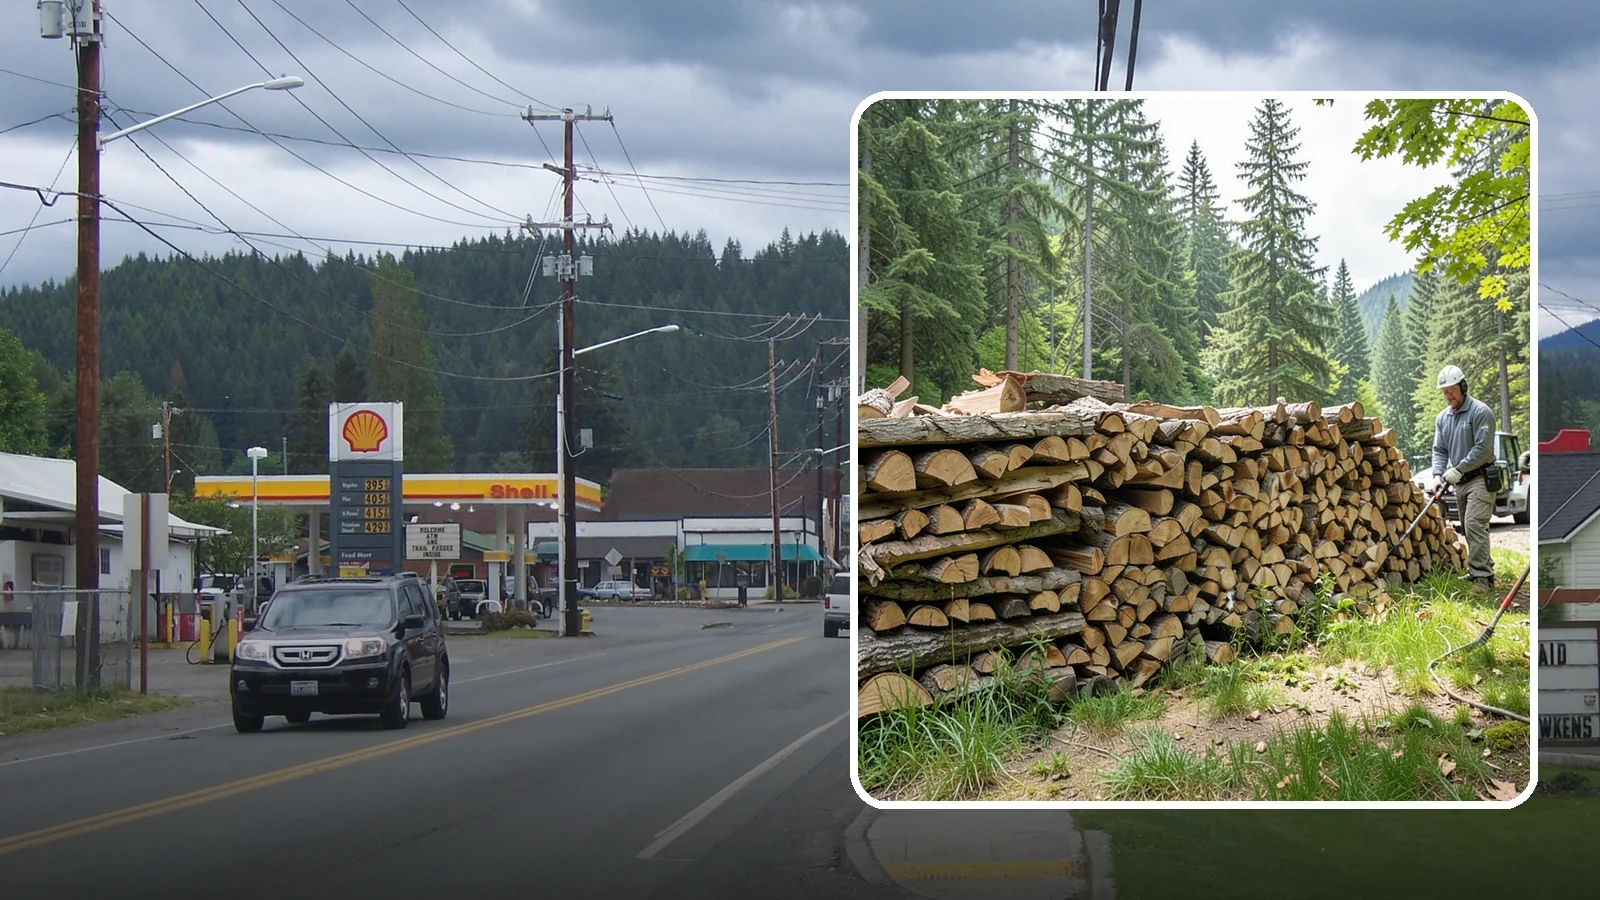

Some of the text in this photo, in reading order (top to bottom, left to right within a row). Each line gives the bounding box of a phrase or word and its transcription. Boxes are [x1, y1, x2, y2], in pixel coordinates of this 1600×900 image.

[365, 480, 383, 490] 395
[490, 484, 547, 499] Shell
[365, 494, 383, 504] 405
[365, 508, 383, 518] 415
[365, 522, 384, 533] 429
